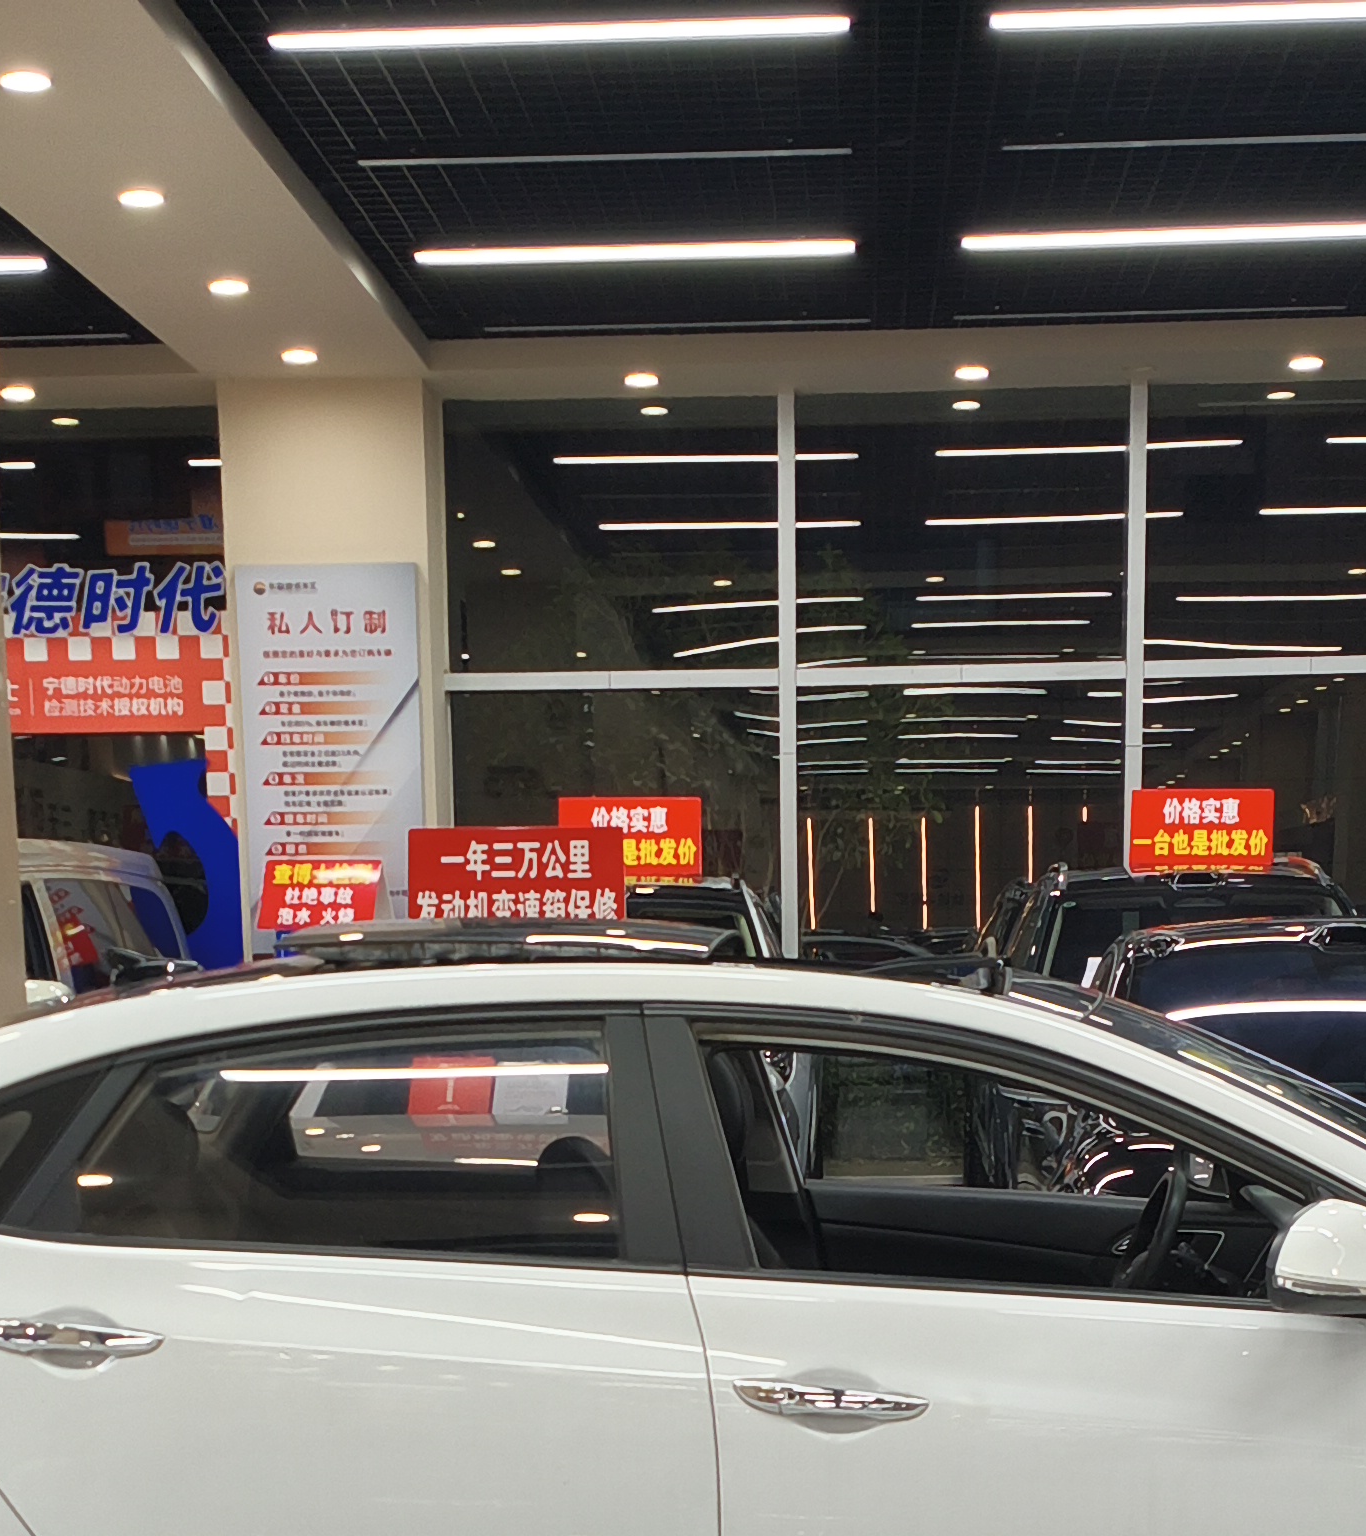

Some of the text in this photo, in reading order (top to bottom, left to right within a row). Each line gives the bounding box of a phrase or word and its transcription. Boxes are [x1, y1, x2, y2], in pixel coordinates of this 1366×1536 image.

[0, 561, 227, 637] 德时代
[267, 609, 387, 635] 私人订制
[43, 675, 183, 695] 宁德时代动力电池
[44, 697, 184, 717] 检测技术授权机构
[591, 806, 668, 833] 价格实惠
[1163, 797, 1240, 824] 价格实惠
[1132, 829, 1268, 856] 一台也是批发价
[440, 840, 592, 881] 一年三万公里
[285, 887, 353, 905] 杜绝事故
[416, 888, 618, 919] 发动机变速箱保修
